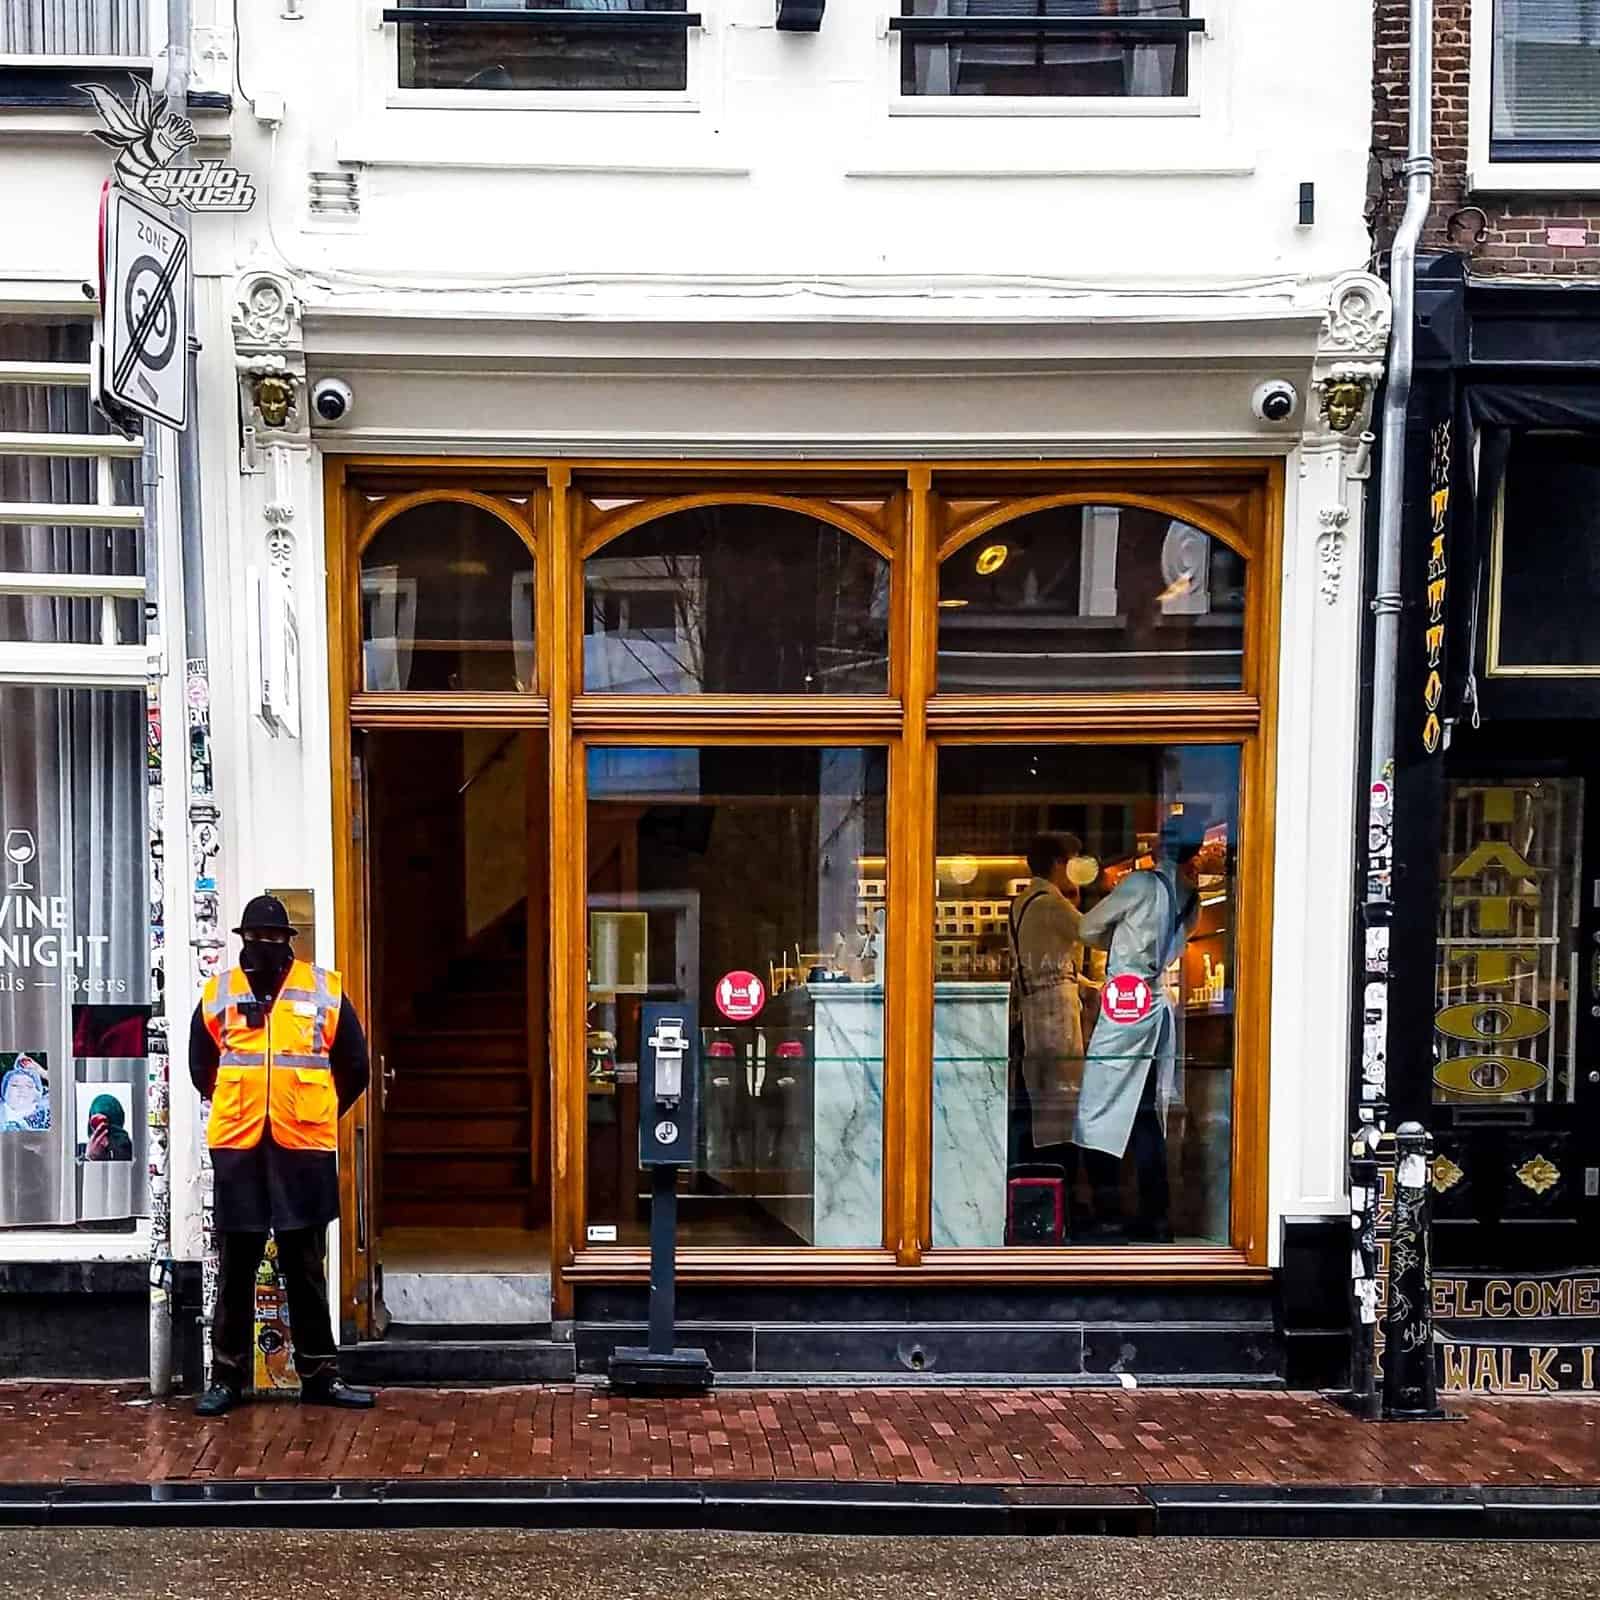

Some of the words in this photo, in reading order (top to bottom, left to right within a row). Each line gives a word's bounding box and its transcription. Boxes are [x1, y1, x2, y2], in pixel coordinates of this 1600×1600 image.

[137, 220, 169, 254] ZONE
[66, 973, 126, 993] Beers
[1431, 1279, 1600, 1318] ELCOME
